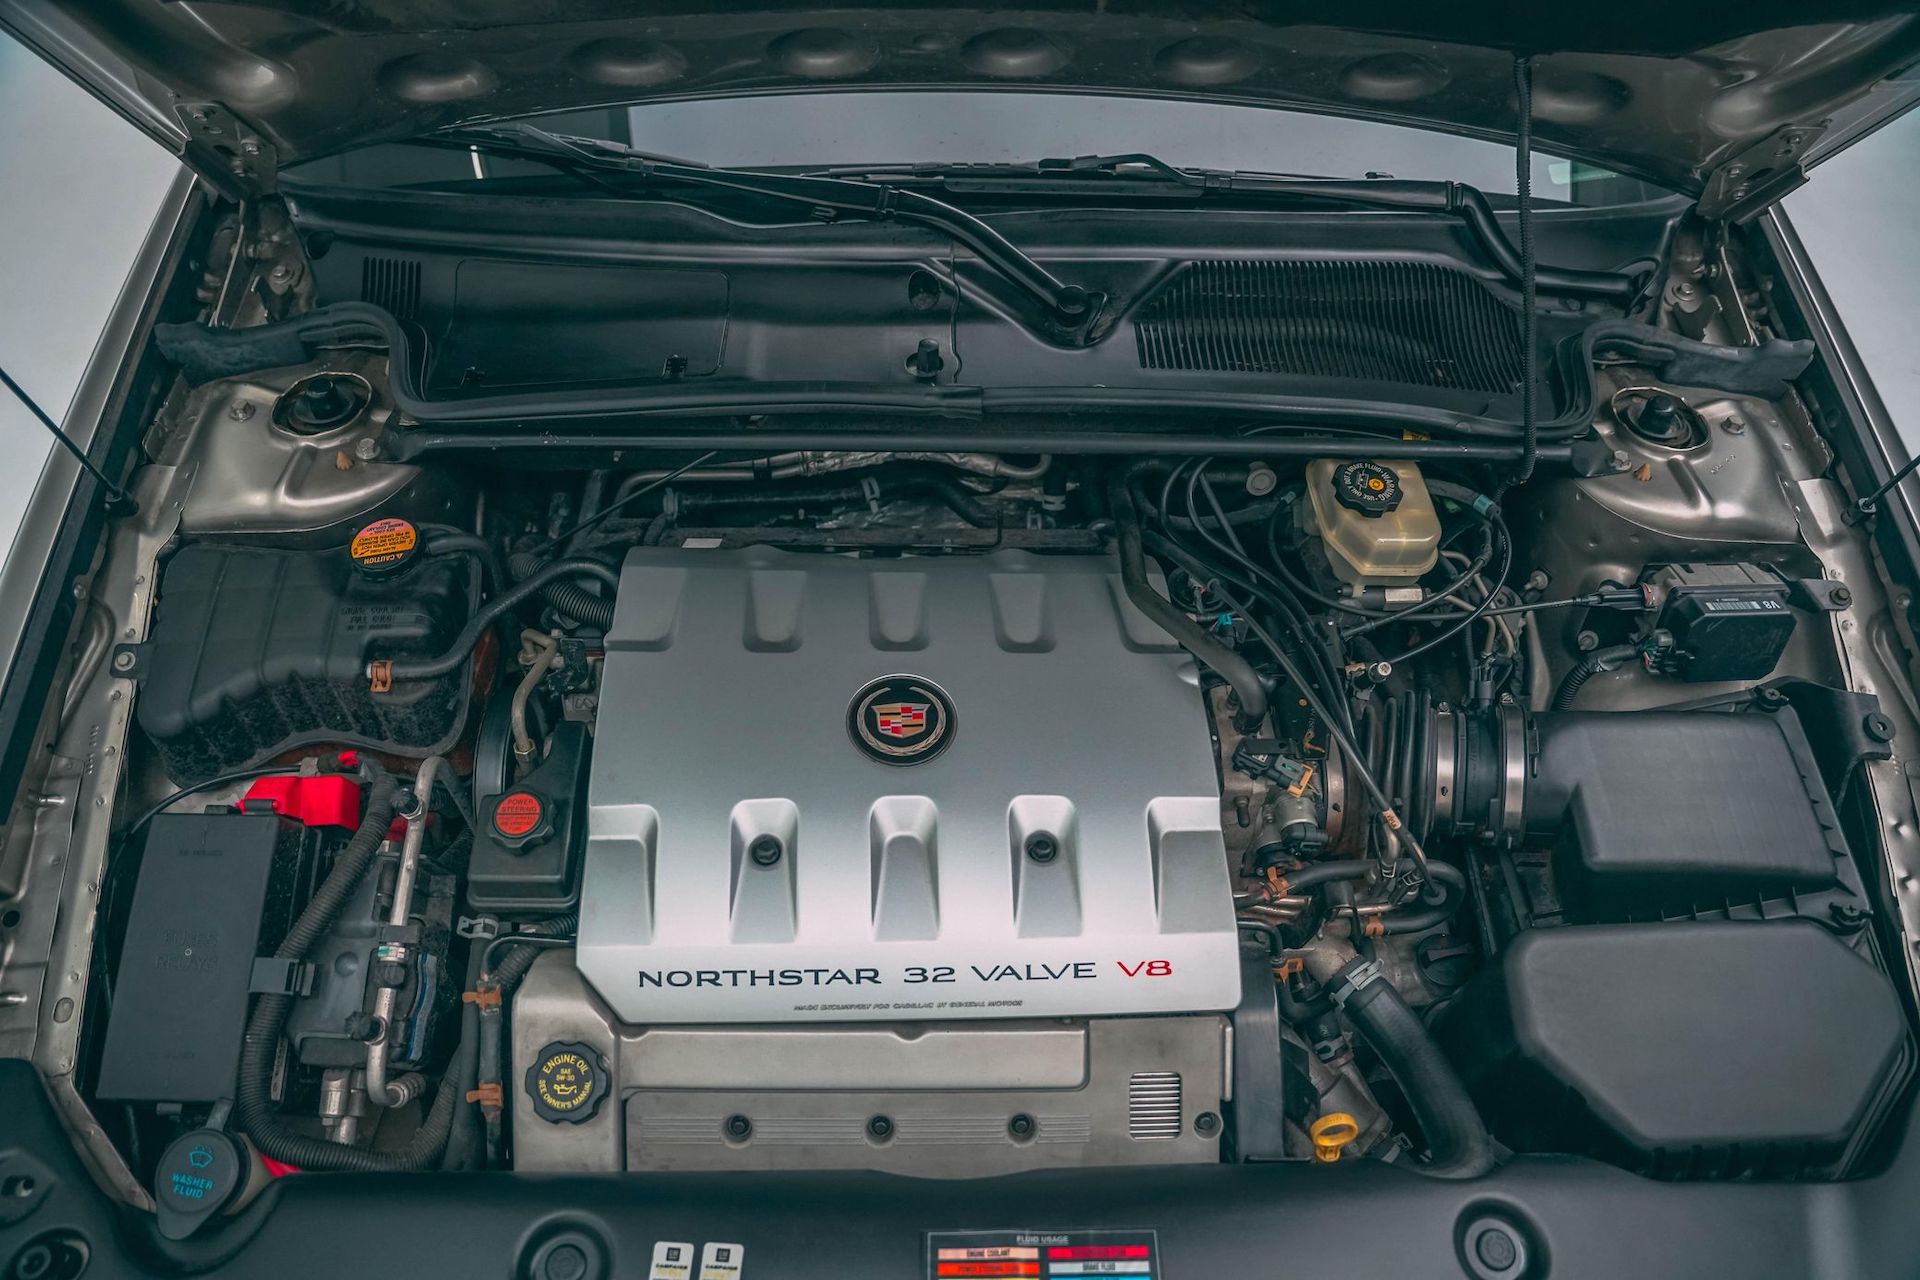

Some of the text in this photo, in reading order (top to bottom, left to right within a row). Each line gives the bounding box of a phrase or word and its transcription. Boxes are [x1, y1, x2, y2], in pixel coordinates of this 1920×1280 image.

[1348, 463, 1364, 473] BRAKE
[1364, 463, 1382, 473] FLUID
[1347, 485, 1362, 497] ONLY
[1378, 472, 1395, 501] WARNING
[1363, 493, 1376, 501] USE
[363, 553, 396, 565] CAUTION
[1763, 601, 1781, 609] V8
[638, 960, 1173, 988] NORTHSTAR 32 VALVE V8
[542, 1054, 589, 1076] ENGINE OIL
[543, 1093, 572, 1109] OWNER'S
[572, 1080, 592, 1106] MANUAL
[171, 1173, 214, 1190] WASHER
[174, 1184, 204, 1199] FLUID
[1016, 1235, 1069, 1243] FLUID USAGE
